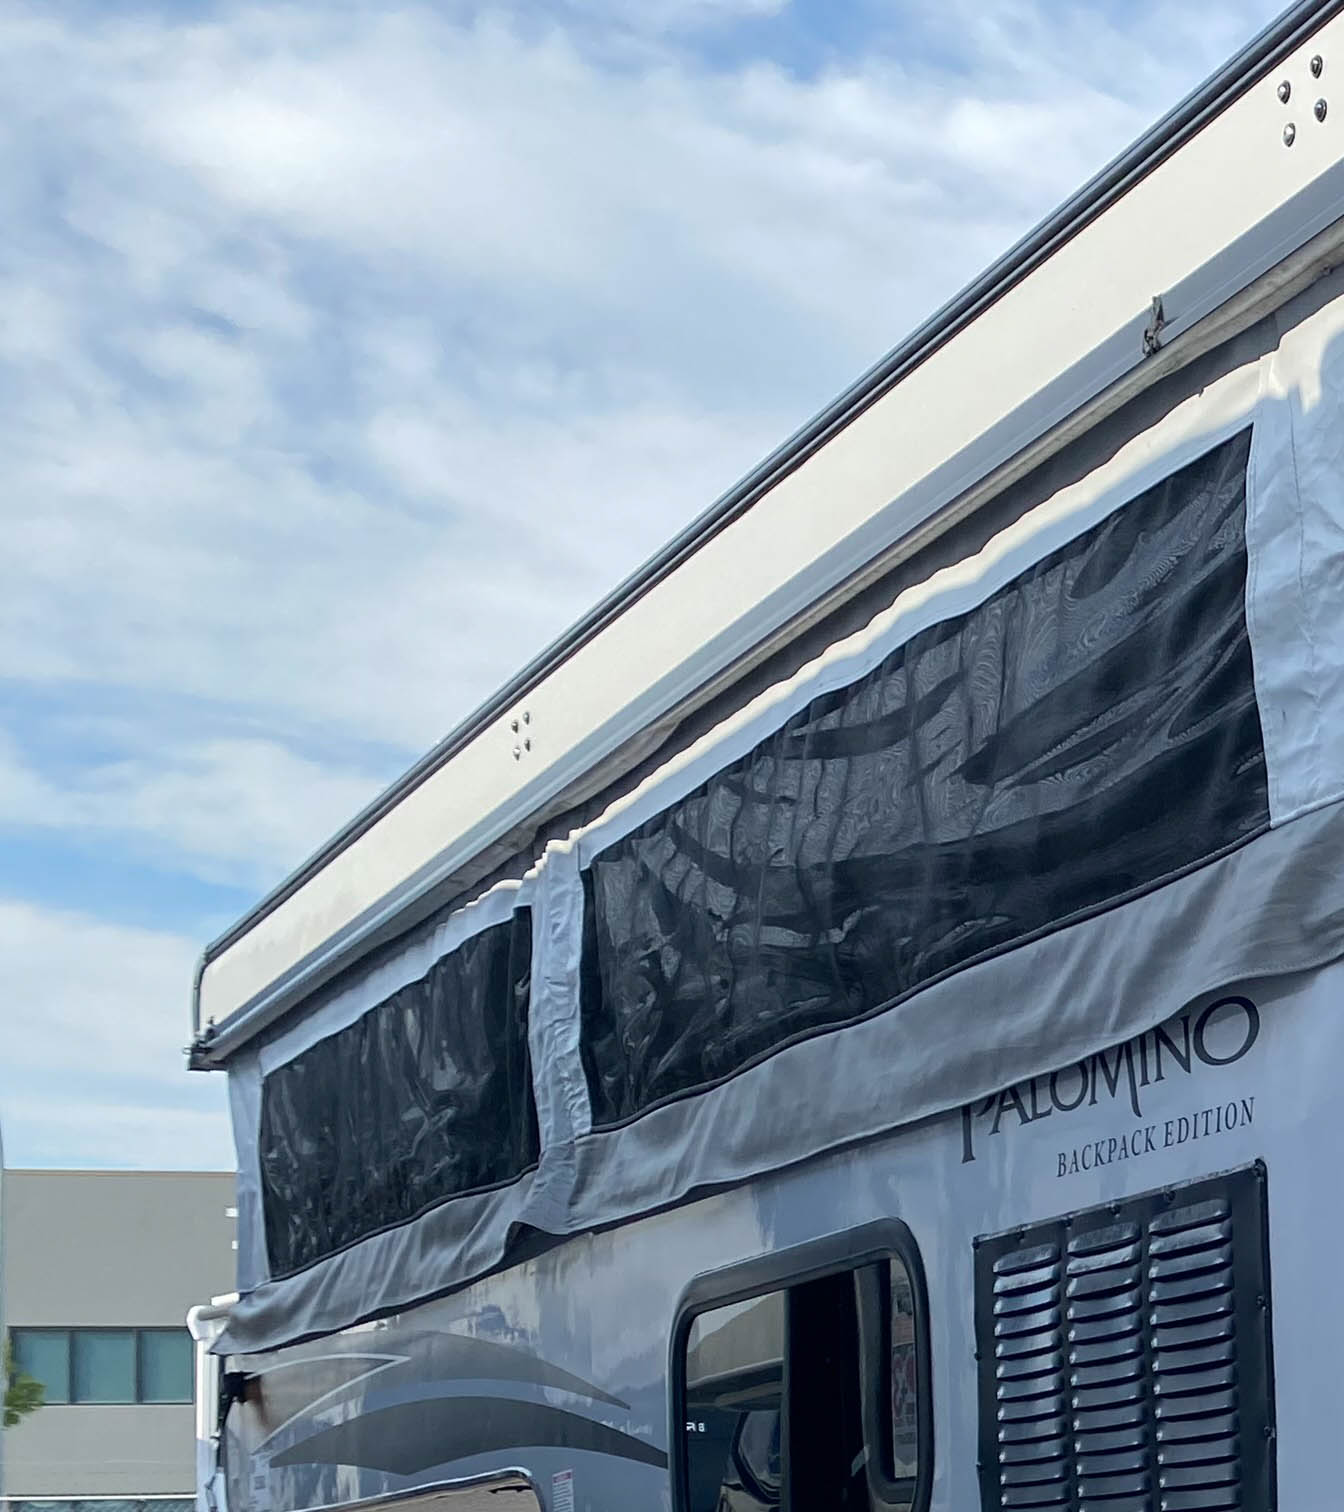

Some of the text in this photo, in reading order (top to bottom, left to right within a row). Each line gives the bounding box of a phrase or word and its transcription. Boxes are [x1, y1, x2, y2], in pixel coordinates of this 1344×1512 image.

[961, 995, 1260, 1164] PALOMINO
[1056, 1097, 1255, 1177] BACKPACK EDITION
